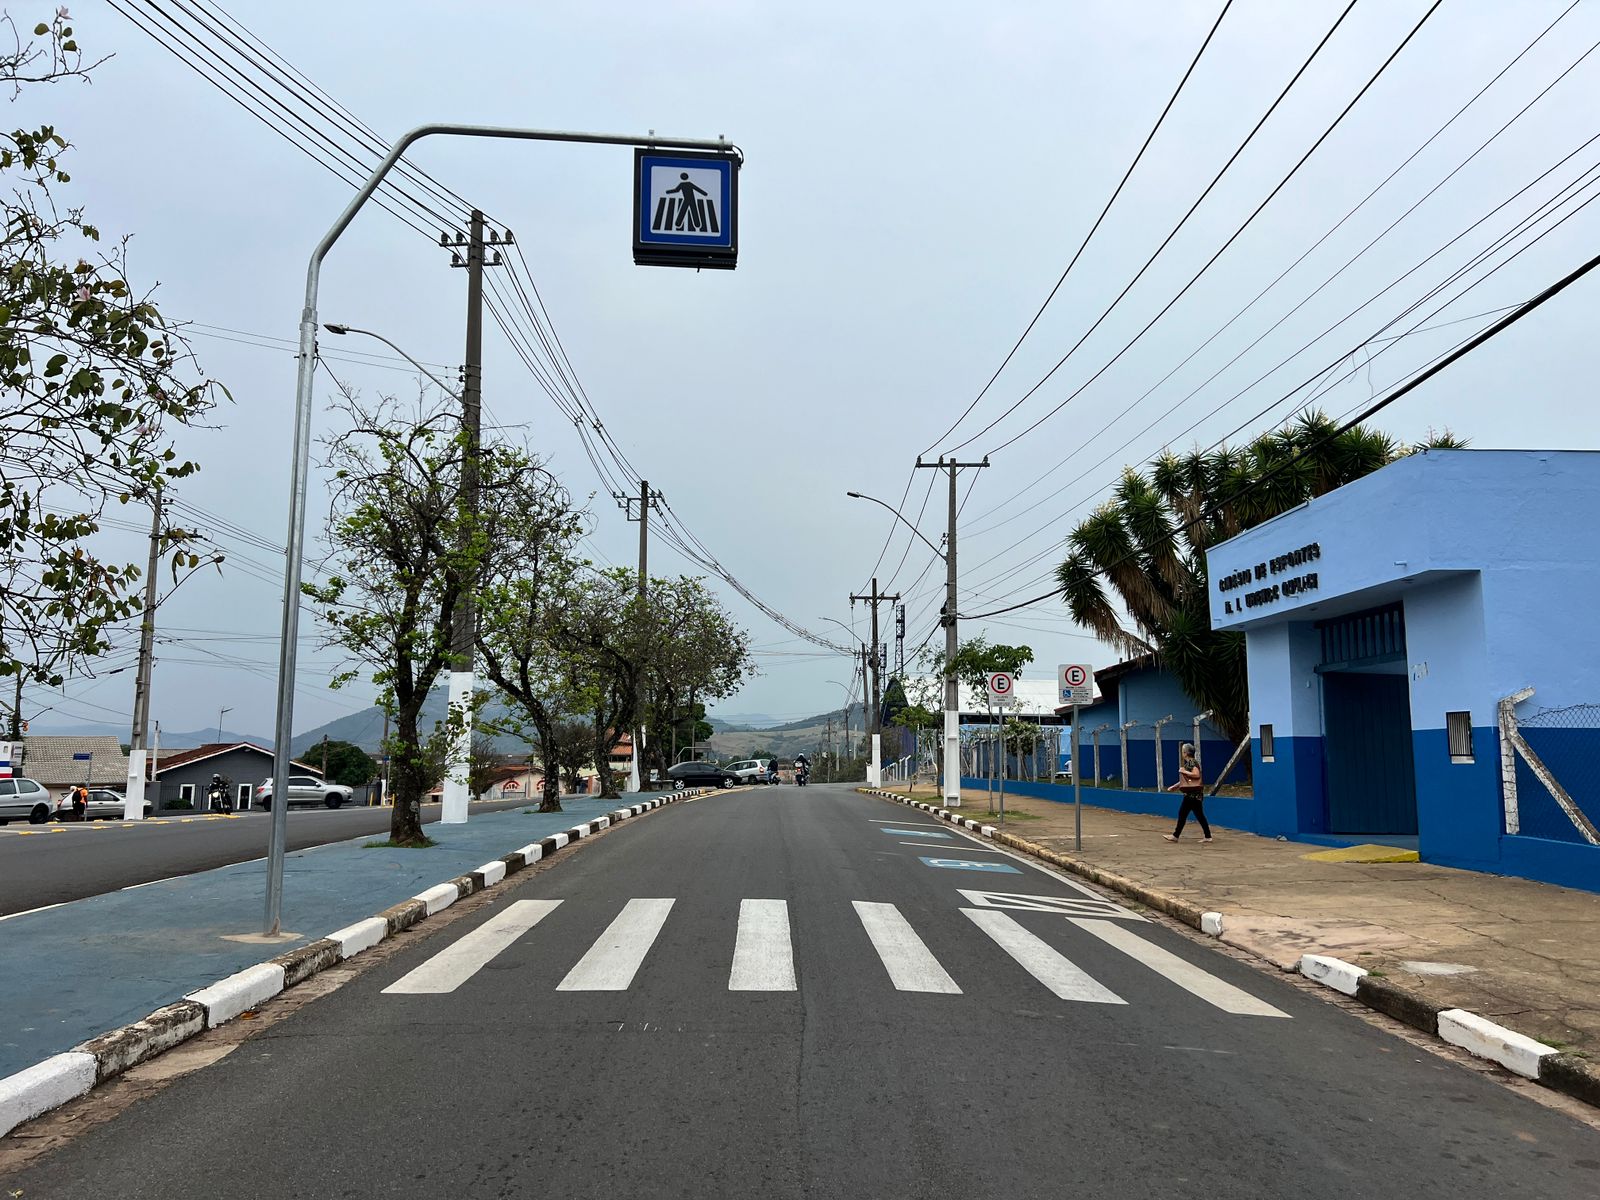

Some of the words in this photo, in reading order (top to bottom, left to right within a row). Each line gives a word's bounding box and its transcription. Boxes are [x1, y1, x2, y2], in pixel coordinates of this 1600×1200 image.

[1254, 562, 1267, 580] DE
[1269, 542, 1321, 575] ESPORTES
[1072, 670, 1080, 682] E
[997, 678, 1005, 690] E
